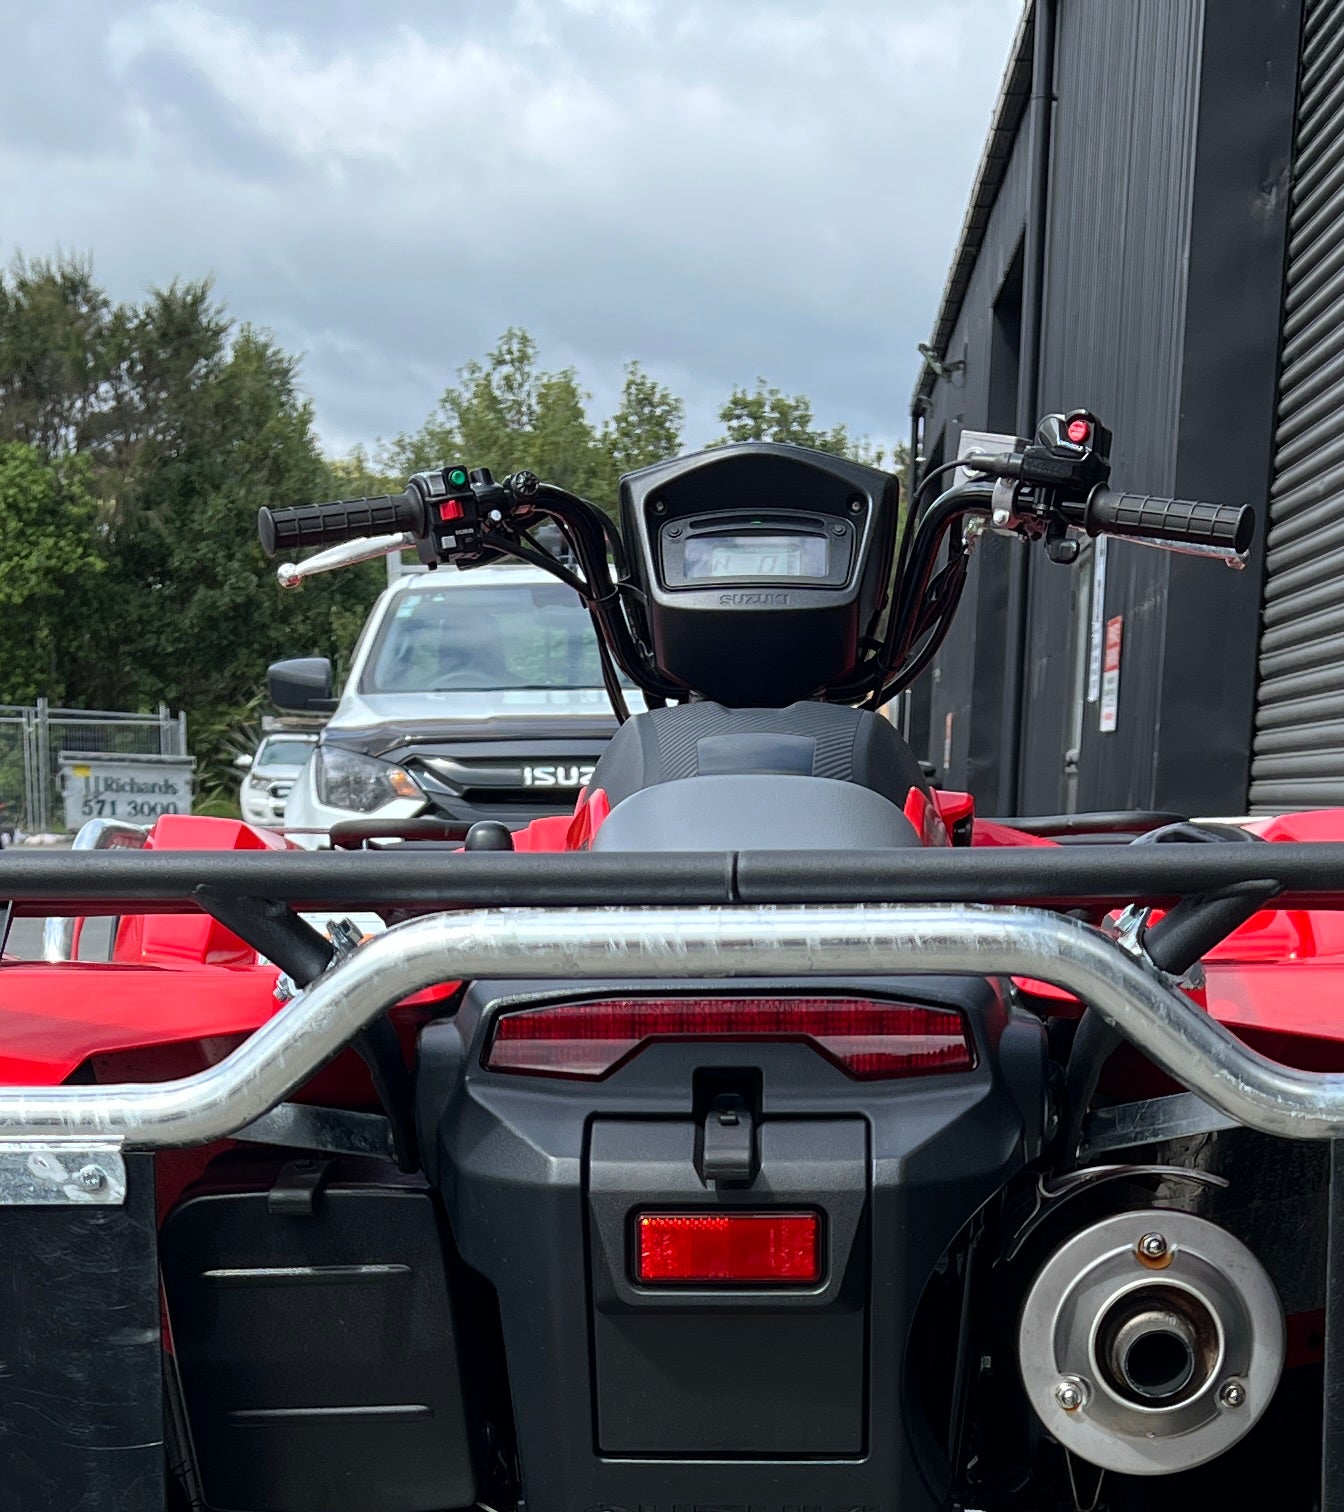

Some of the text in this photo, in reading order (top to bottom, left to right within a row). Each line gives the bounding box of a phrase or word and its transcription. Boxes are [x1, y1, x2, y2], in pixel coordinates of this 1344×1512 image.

[719, 593, 791, 605] SUZUKI
[82, 798, 178, 817] 571 3000
